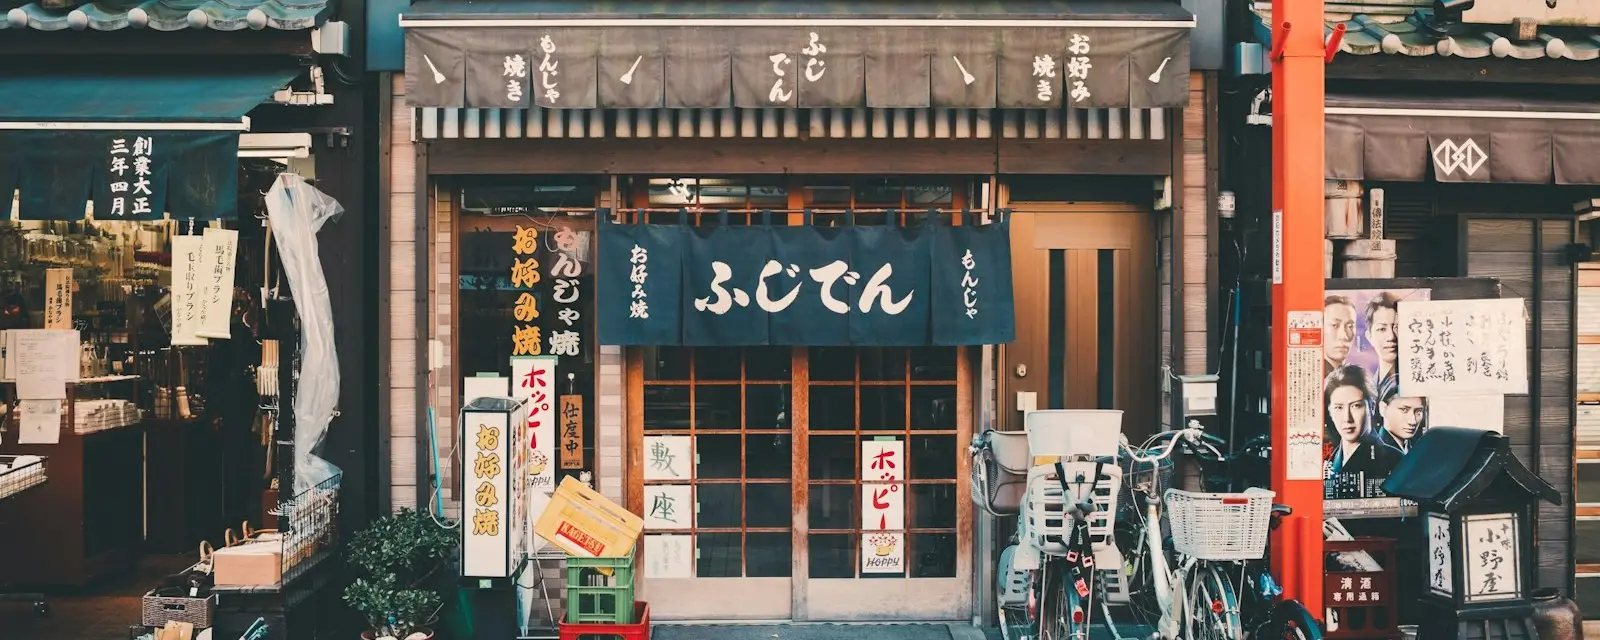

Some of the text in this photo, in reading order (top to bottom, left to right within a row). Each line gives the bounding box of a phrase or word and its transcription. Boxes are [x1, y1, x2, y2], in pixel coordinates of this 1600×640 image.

[503, 53, 526, 102] 焼き
[539, 34, 561, 104] もんじゃ
[769, 52, 792, 102] でん
[802, 31, 827, 82] ふじ
[1032, 53, 1056, 102] 焼き
[1067, 33, 1093, 103] お好み
[110, 138, 130, 216] 三年四月
[131, 136, 153, 215] 創業大正
[512, 225, 542, 356] お好み焼
[549, 226, 583, 356] もんじゃ焼
[629, 244, 649, 319] お好み焼
[694, 259, 915, 316] ふじでん
[960, 249, 979, 320] もんじゃ
[521, 364, 551, 449] ホッピー
[562, 401, 580, 456] 仕度中
[473, 423, 501, 536] お好み焼
[649, 441, 680, 477] 敷
[871, 446, 899, 531] ホッピー
[649, 491, 679, 524] 座
[1340, 577, 1372, 590] 清酒
[1478, 528, 1504, 594] 小野屋
